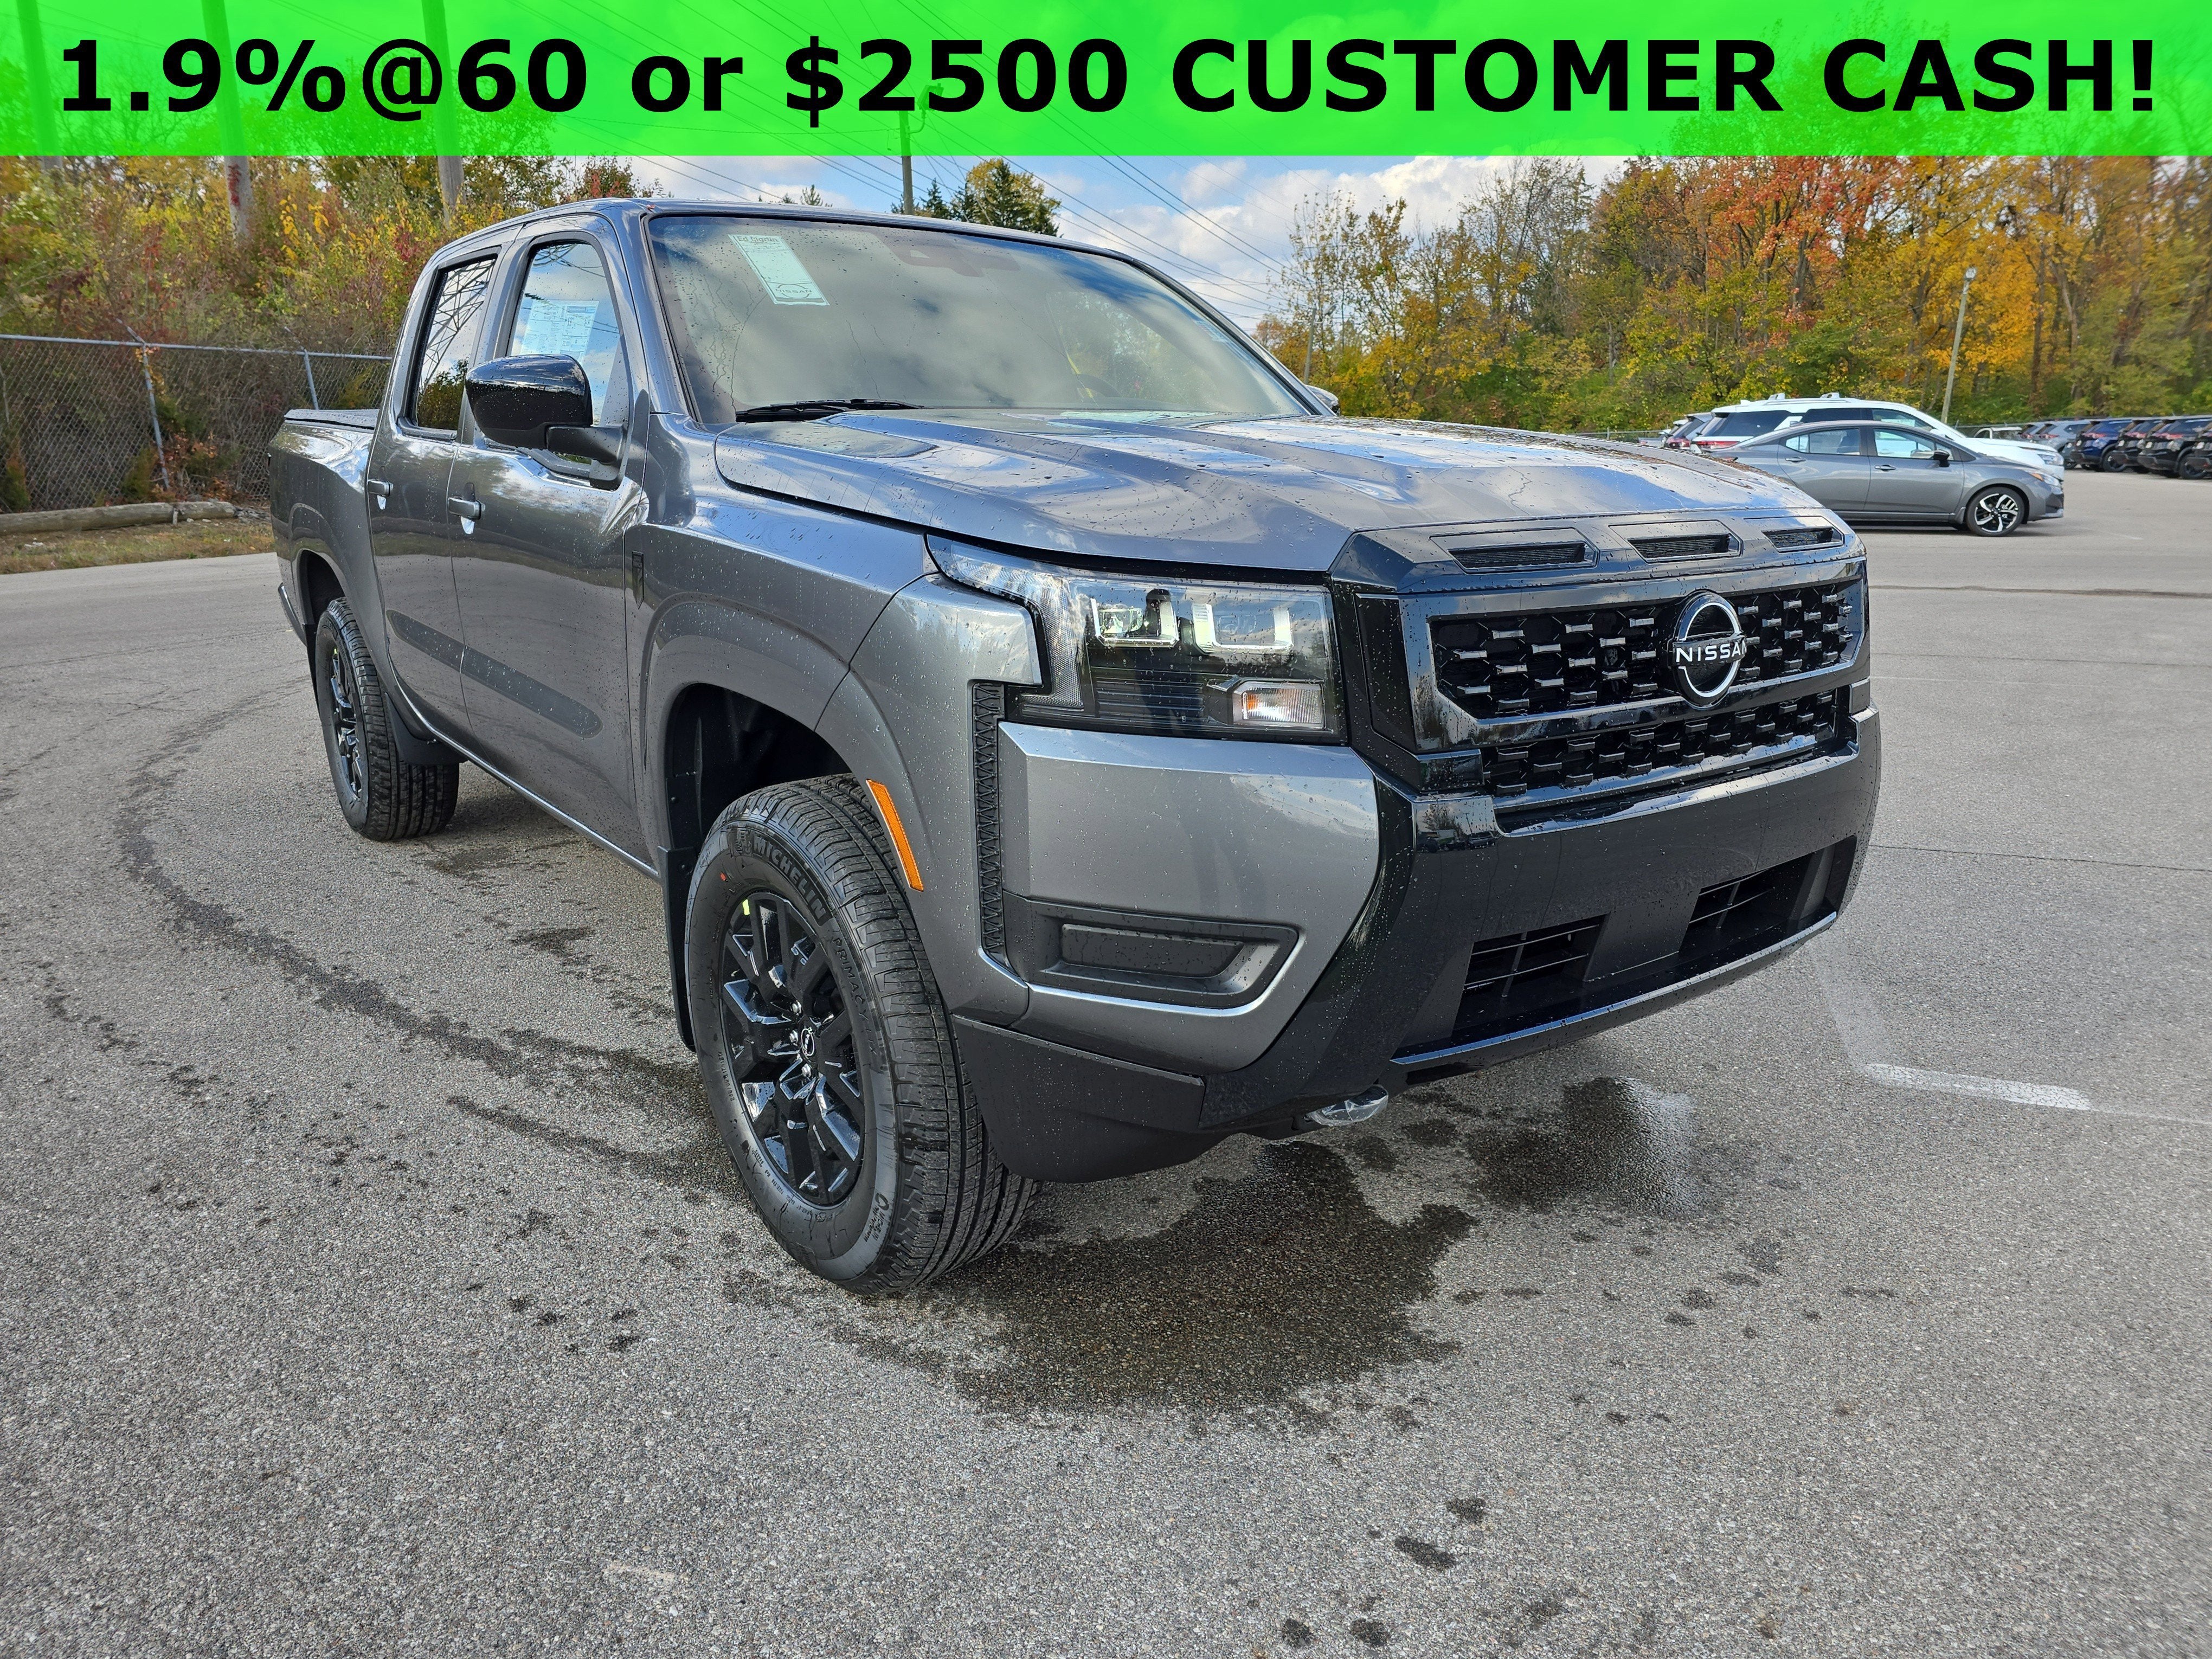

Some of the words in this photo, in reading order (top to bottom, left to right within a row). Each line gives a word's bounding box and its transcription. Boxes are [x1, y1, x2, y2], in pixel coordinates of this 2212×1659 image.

[1676, 640, 1747, 663] NISSAN
[754, 833, 826, 919] MICHELIN
[833, 937, 869, 1021] PRIMACY
